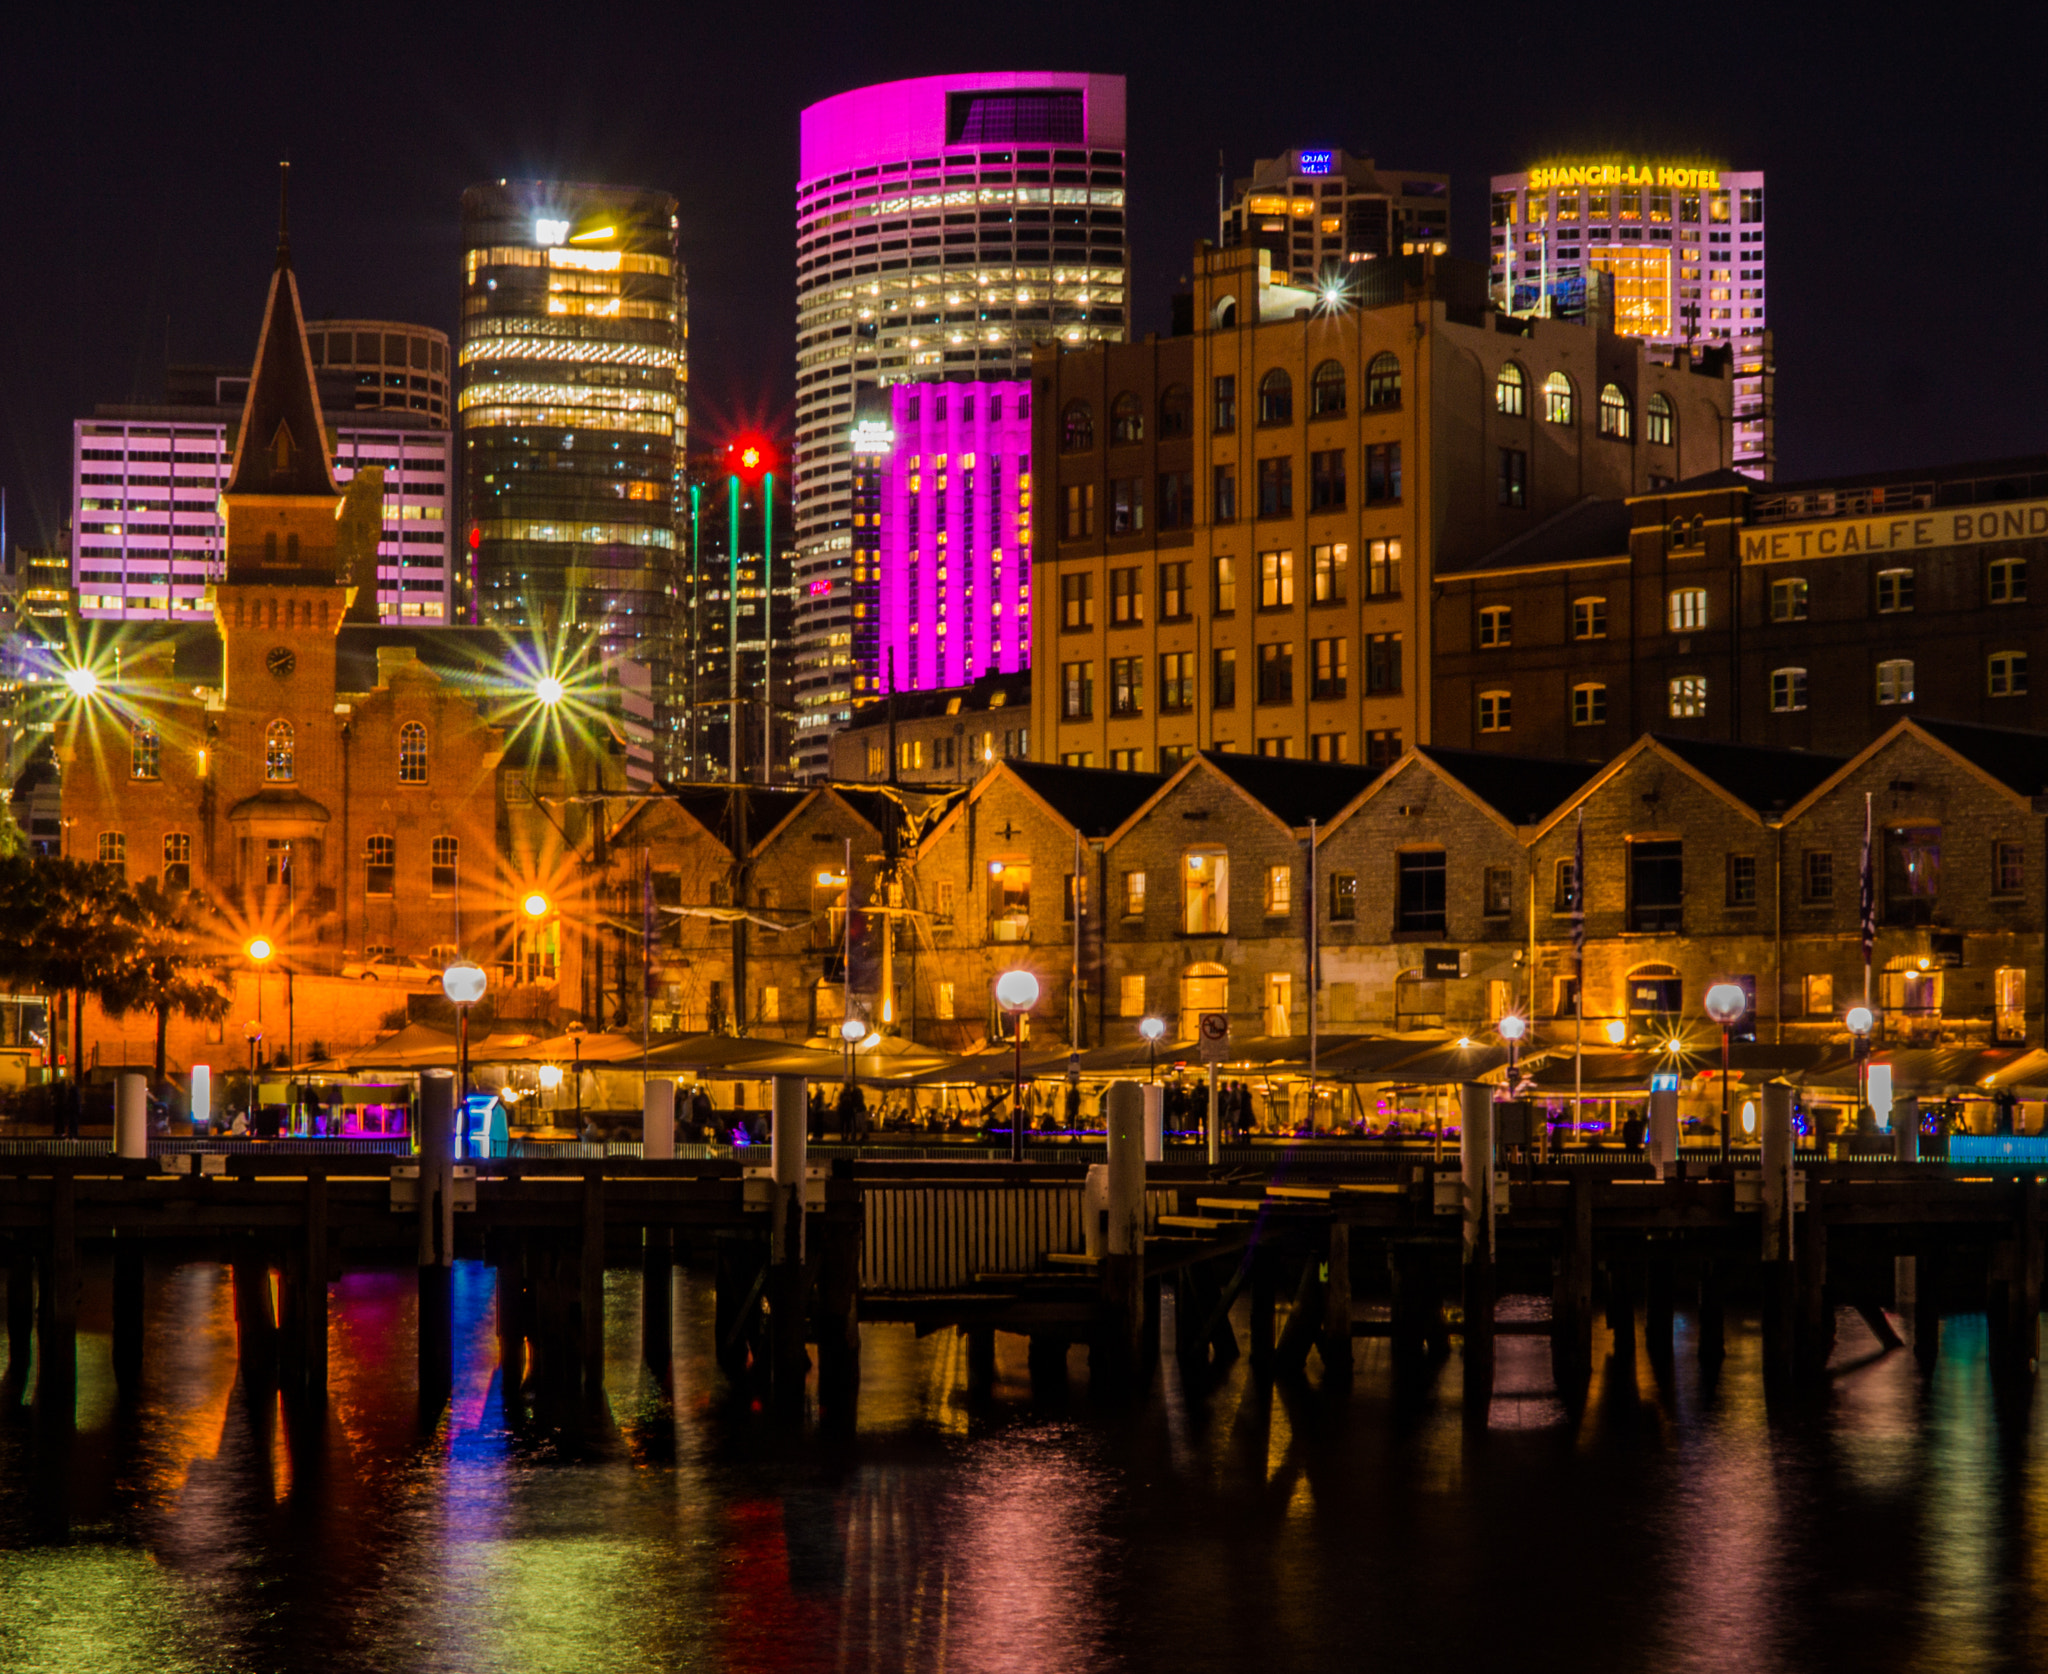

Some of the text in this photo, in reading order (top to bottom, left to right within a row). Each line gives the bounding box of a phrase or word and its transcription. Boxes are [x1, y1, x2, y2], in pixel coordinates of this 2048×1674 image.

[1529, 165, 1721, 190] SHANGRI-LA HOTEL
[1745, 506, 2048, 562] METCALFE BOND
